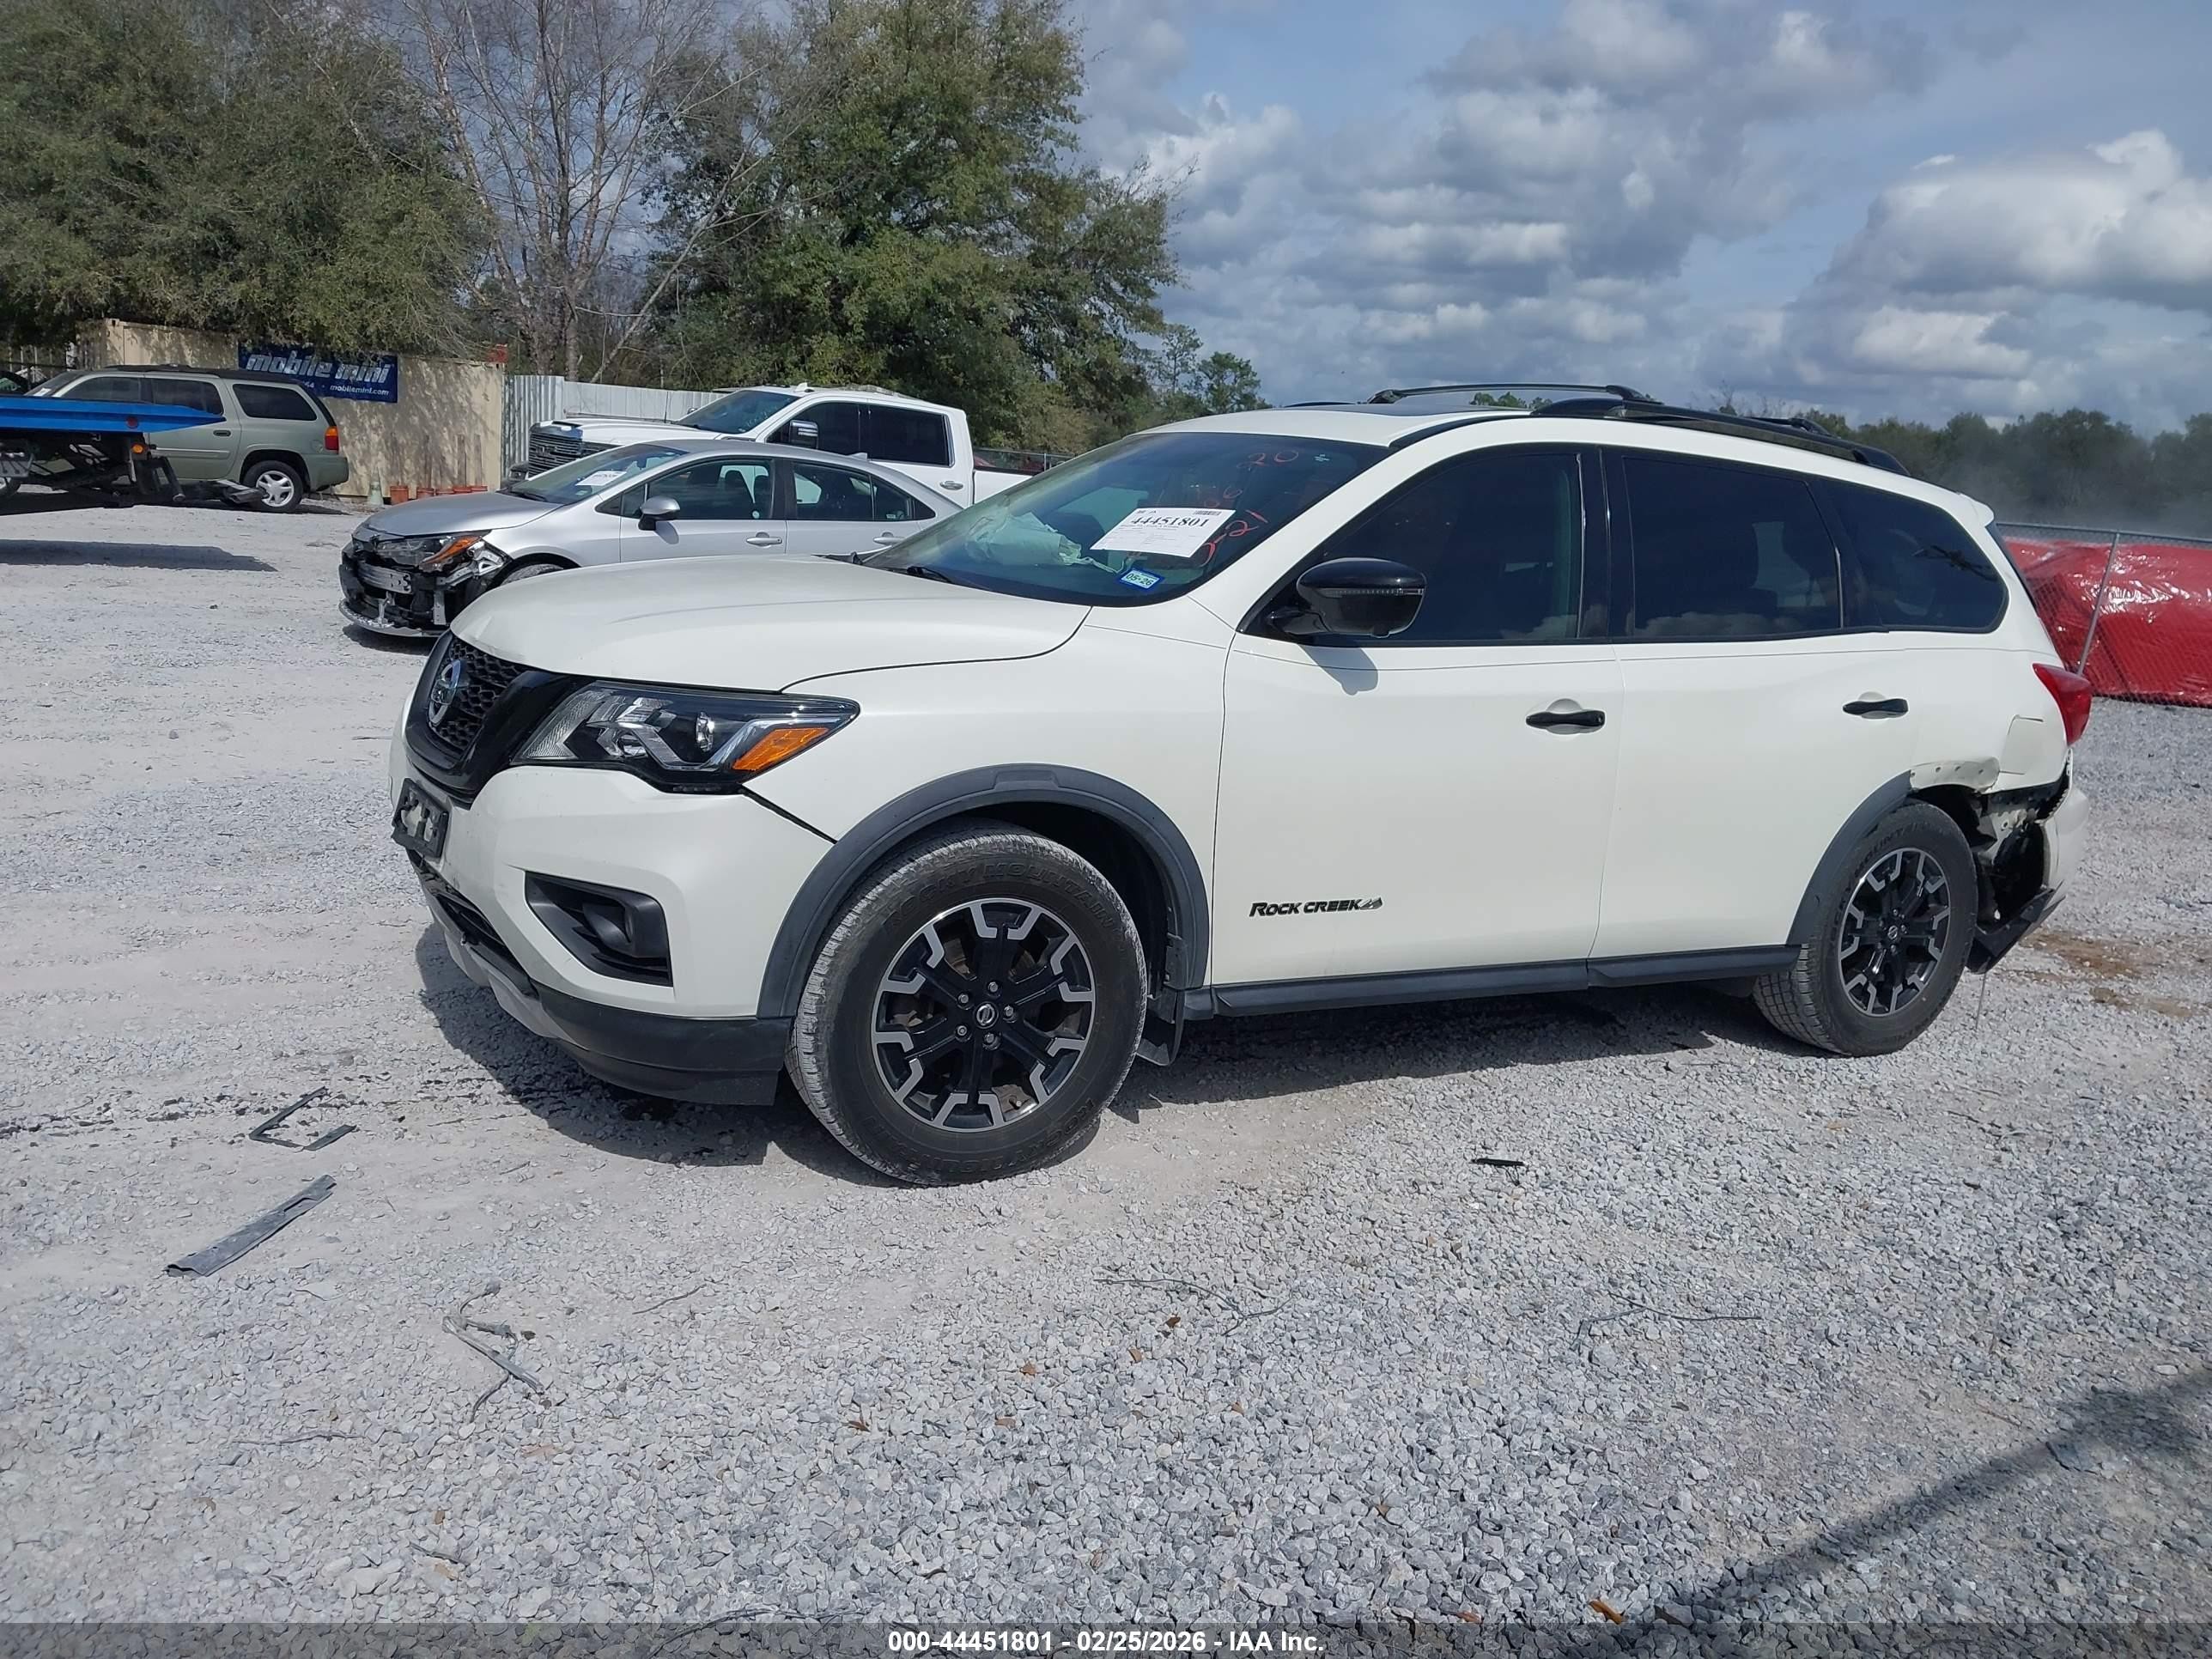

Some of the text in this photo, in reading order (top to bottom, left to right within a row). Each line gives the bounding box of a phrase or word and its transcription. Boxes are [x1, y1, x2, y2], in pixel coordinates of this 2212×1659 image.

[245, 350, 391, 384] mobile mini
[330, 384, 390, 396] mobilemini.com
[1131, 516, 1210, 527] 44451801
[1249, 899, 1362, 917] ROCK CREEK
